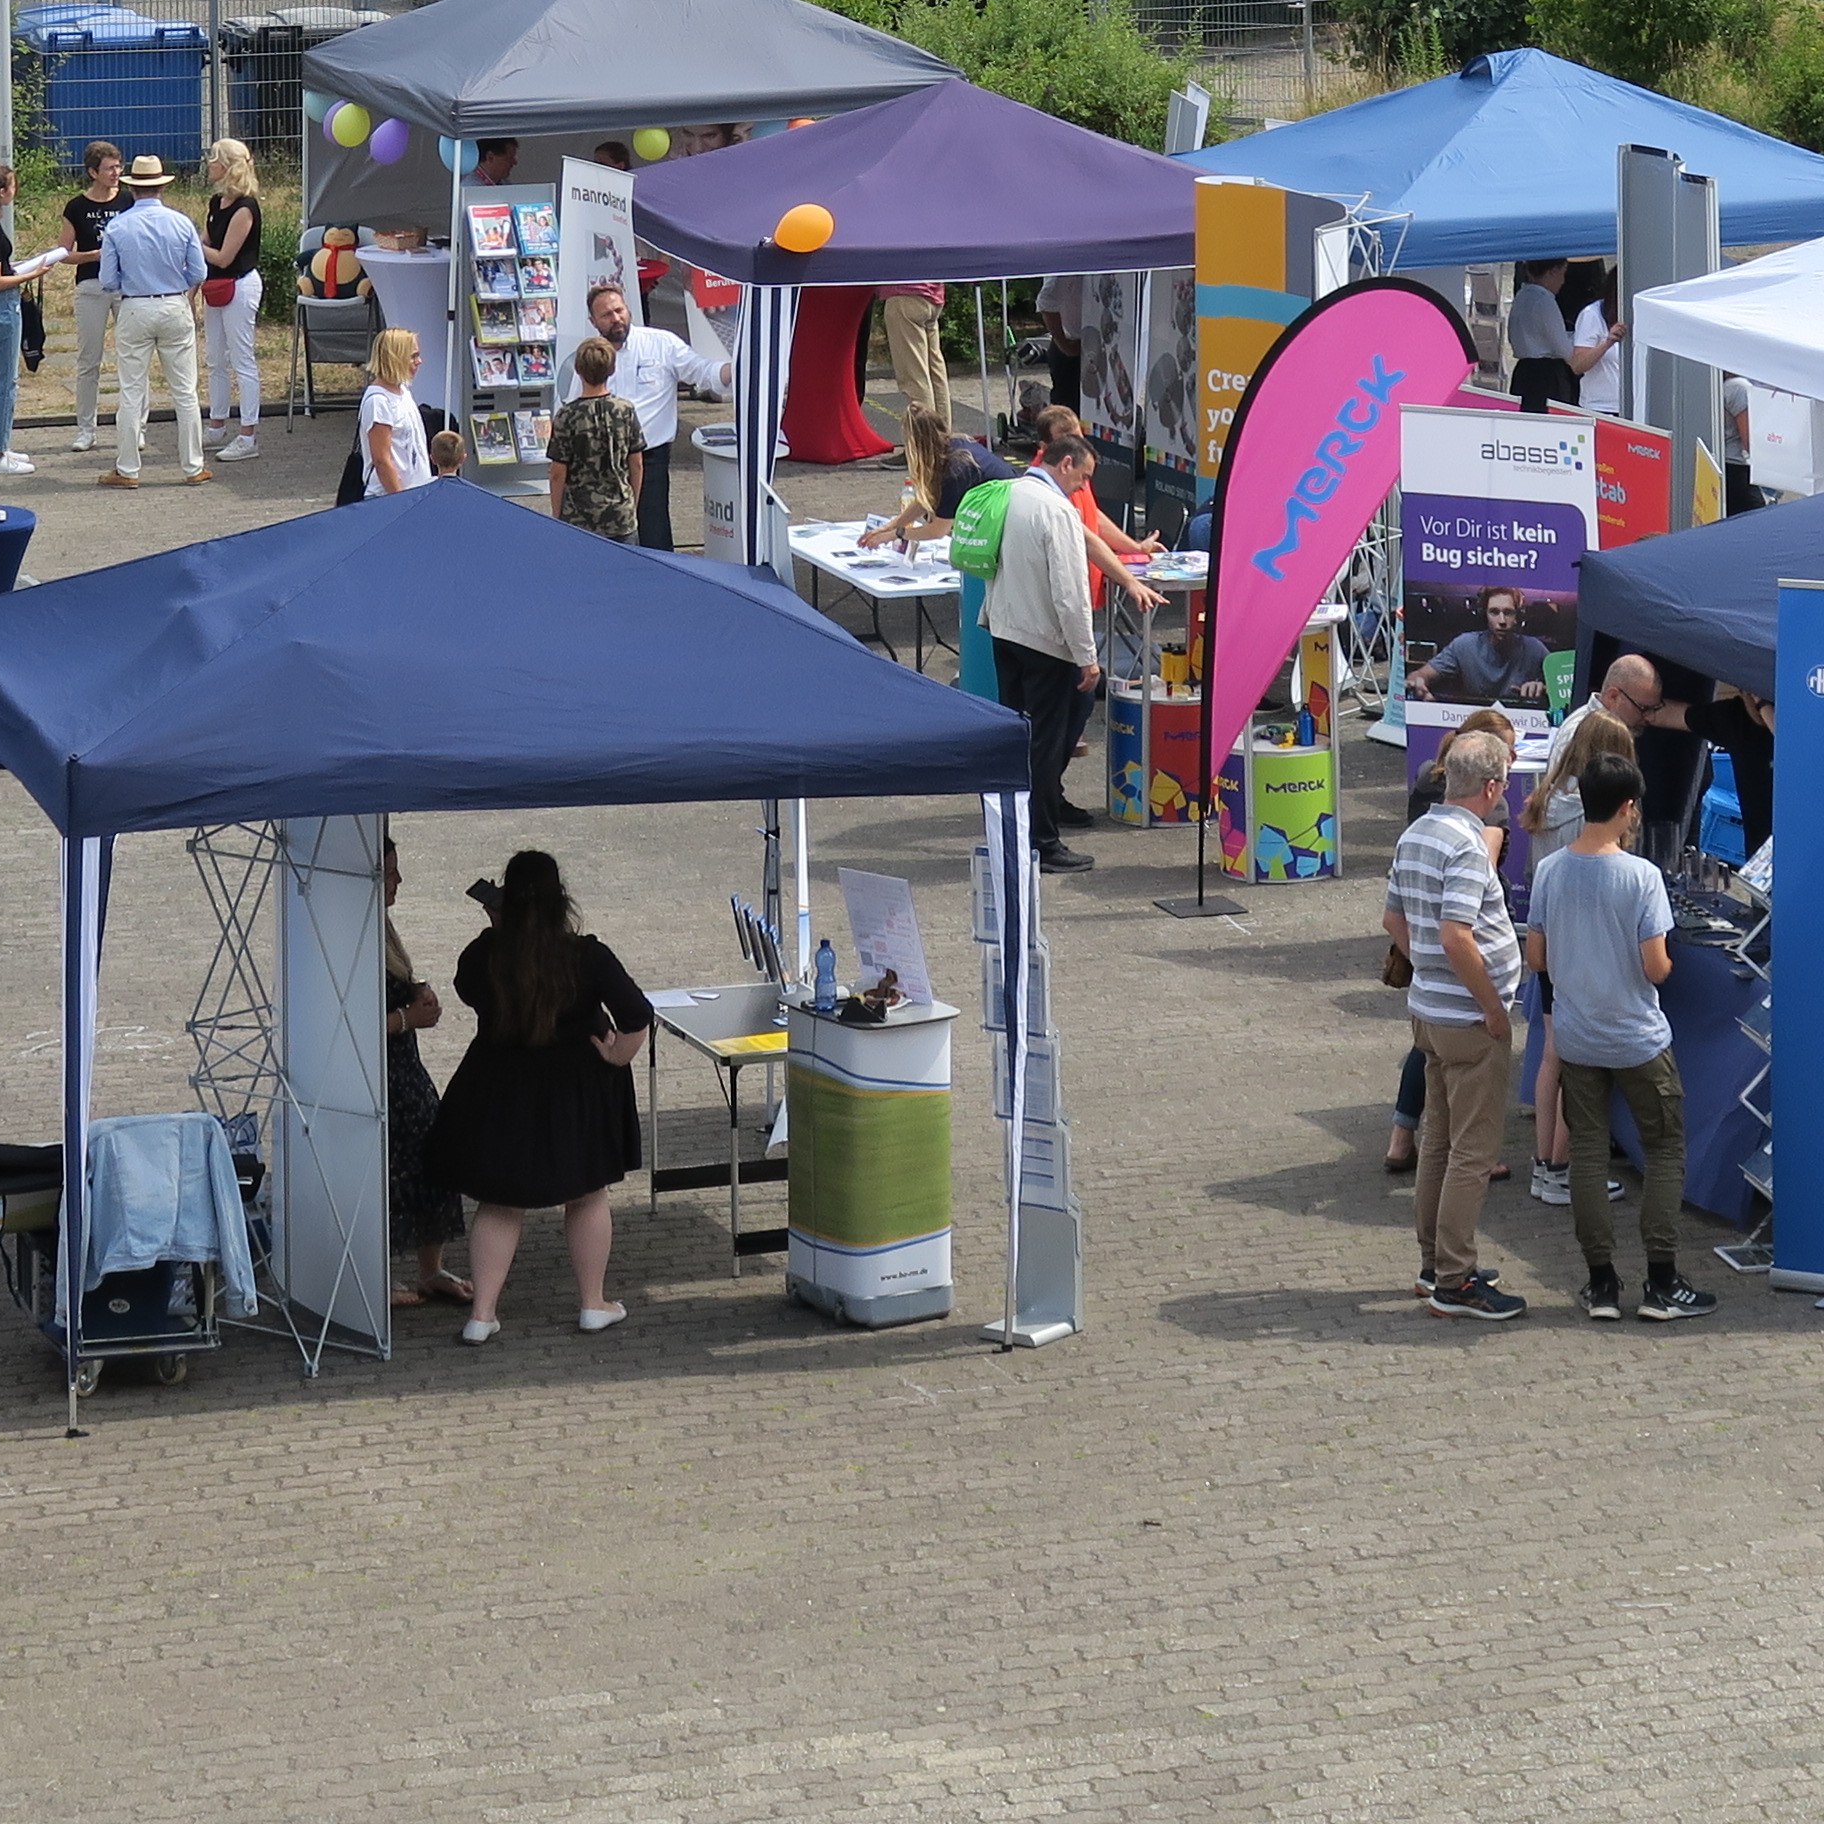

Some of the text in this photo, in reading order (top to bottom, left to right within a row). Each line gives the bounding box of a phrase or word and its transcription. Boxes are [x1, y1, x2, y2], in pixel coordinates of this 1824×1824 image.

[571, 186, 628, 213] manroland
[86, 211, 102, 219] ALL
[1207, 368, 1250, 393] Cre
[1481, 439, 1558, 465] abass
[1628, 443, 1662, 461] MERCK
[1251, 354, 1406, 581] MERCK
[1420, 515, 1558, 545] Vor Dir ist kein
[1421, 543, 1538, 570] Bug sicher?
[1511, 718, 1528, 727] wir
[1530, 715, 1550, 728] Dic
[1265, 777, 1326, 795] MERCK
